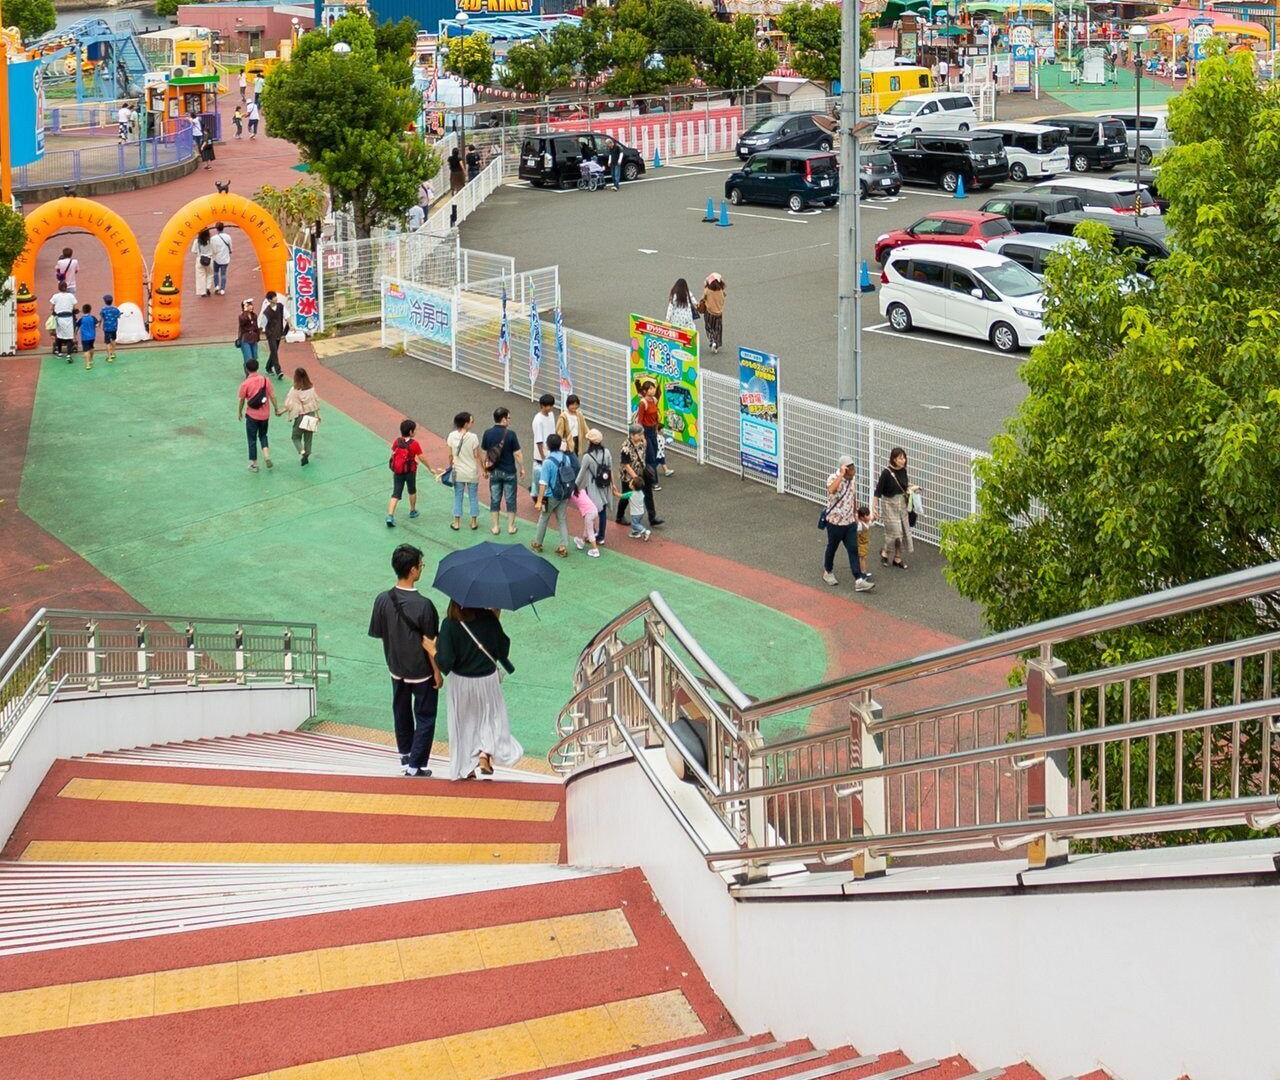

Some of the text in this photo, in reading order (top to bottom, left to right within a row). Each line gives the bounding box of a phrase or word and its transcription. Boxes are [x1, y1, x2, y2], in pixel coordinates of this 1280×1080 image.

[57, 208, 130, 255] HALLOWEEN
[168, 205, 279, 255] HAPPY HALLOWEEN
[296, 253, 318, 316] かき氷
[409, 298, 449, 333] 冷房中
